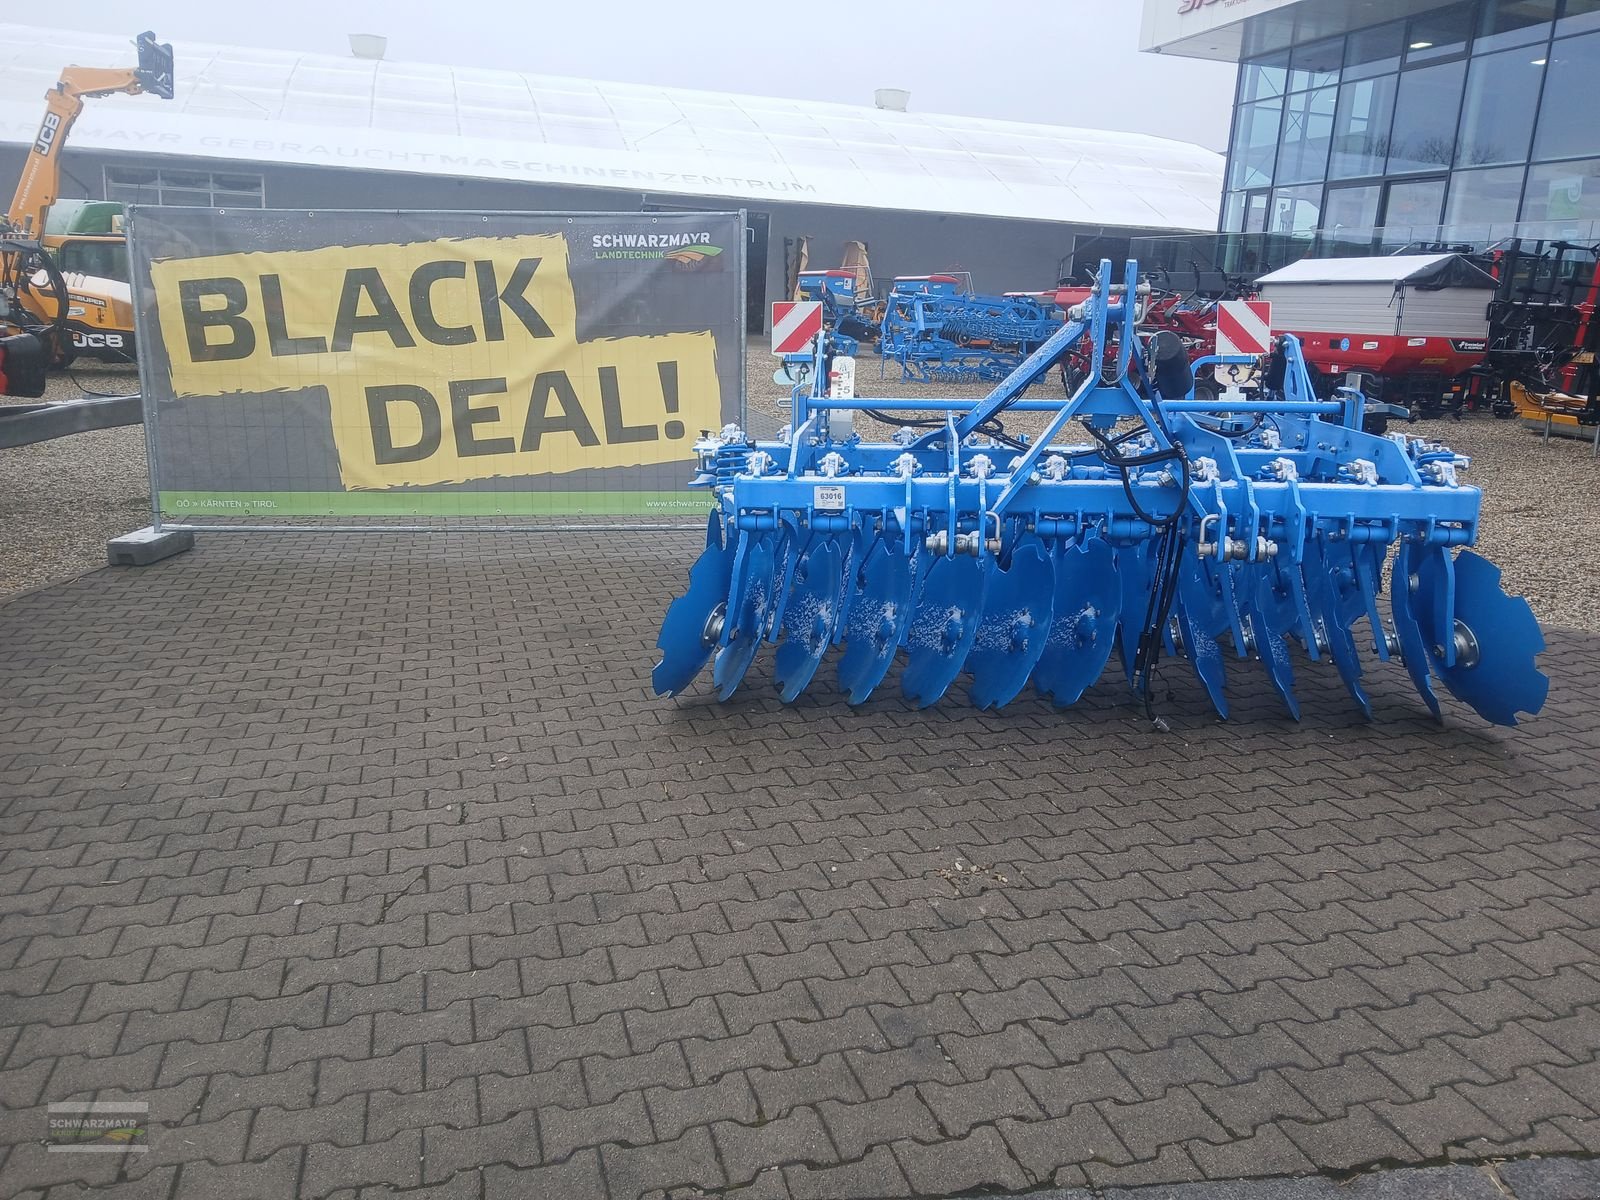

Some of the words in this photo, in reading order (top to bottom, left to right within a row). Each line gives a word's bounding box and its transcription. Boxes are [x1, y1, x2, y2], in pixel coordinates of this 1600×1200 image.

[40, 112, 61, 155] JCB
[199, 134, 817, 193] GEBRAUCHTMASCHINENZENTRUM
[592, 232, 711, 248] SCHWARZMAYR
[595, 250, 664, 259] LANDTECHNIK
[178, 257, 555, 363] BLACK
[72, 334, 124, 348] JCB
[364, 360, 685, 466] DEAL!
[252, 500, 278, 508] TIROL
[820, 492, 842, 500] 63016
